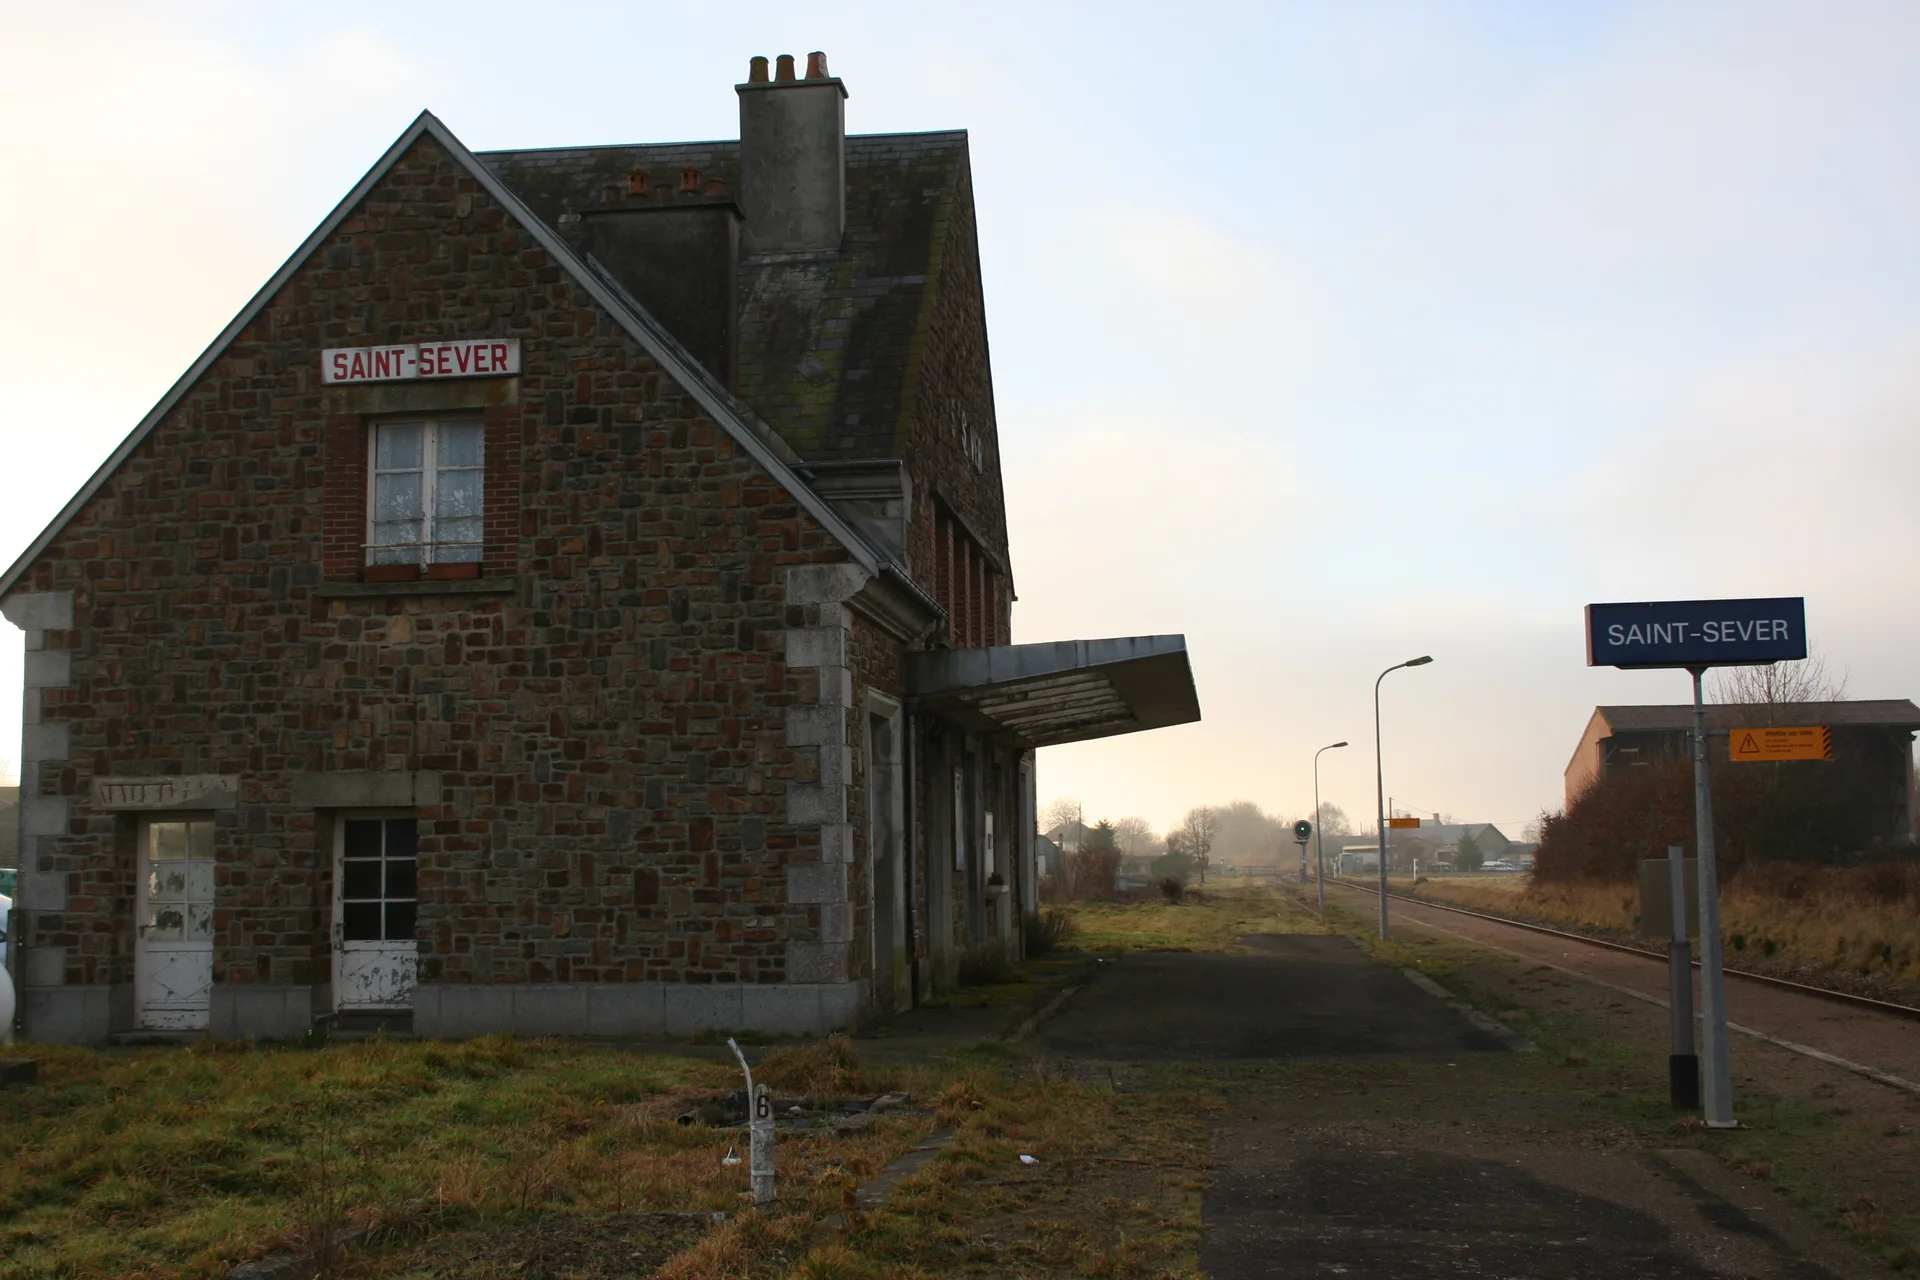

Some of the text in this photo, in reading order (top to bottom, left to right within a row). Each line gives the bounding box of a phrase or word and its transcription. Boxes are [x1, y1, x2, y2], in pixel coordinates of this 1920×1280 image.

[333, 344, 508, 380] SAINT-SEVER
[1607, 619, 1789, 646] SAINT-SEVER
[756, 1095, 769, 1118] 6
